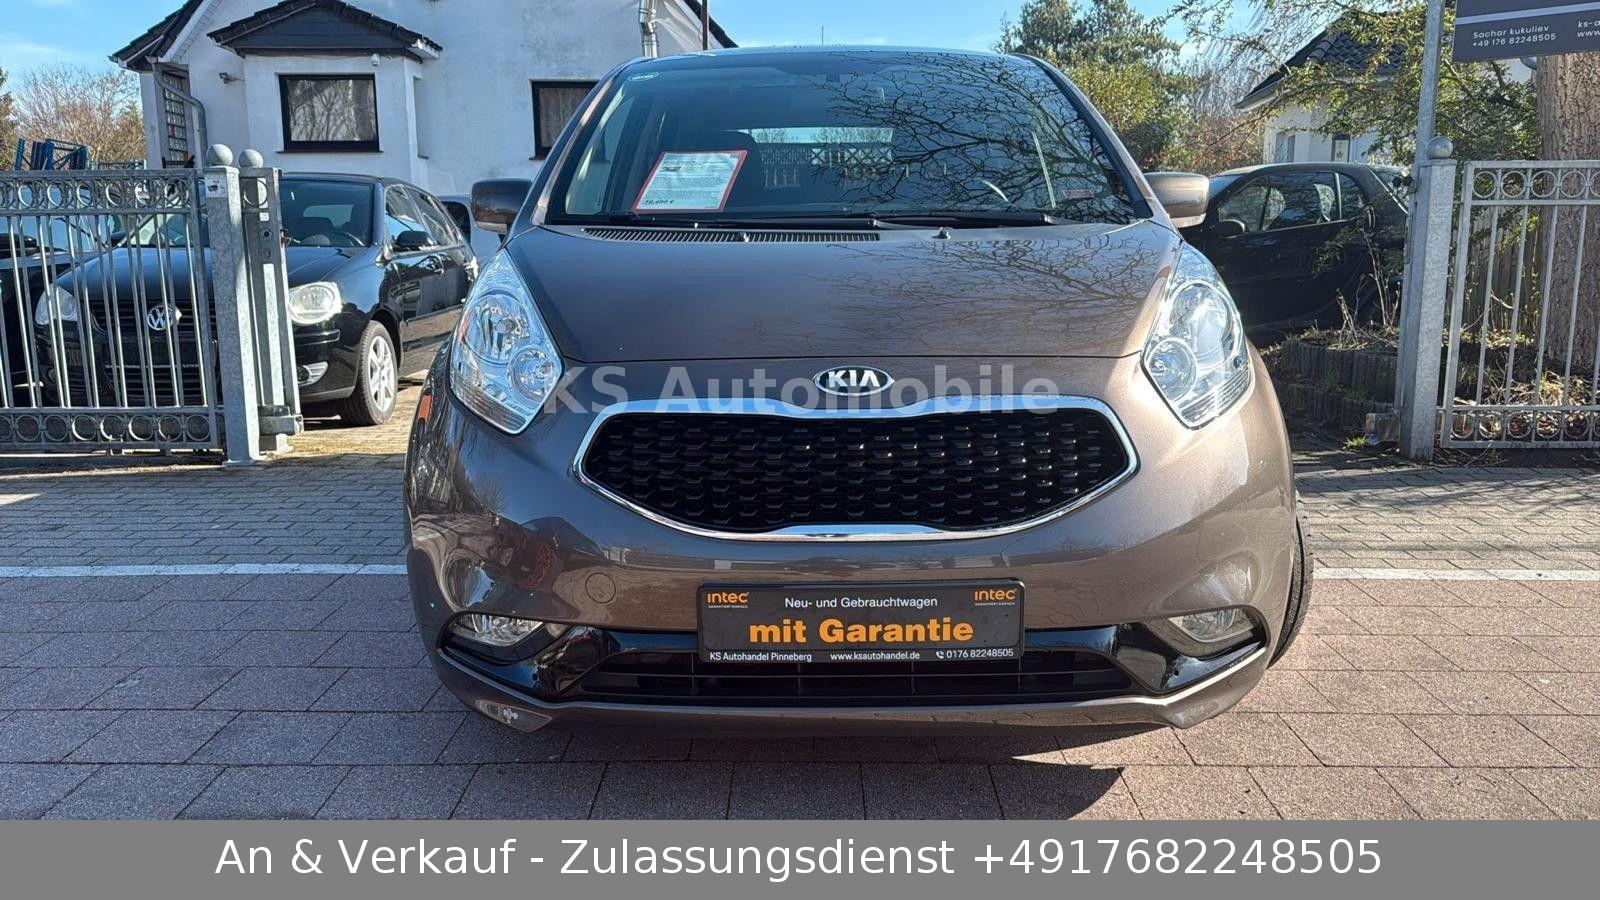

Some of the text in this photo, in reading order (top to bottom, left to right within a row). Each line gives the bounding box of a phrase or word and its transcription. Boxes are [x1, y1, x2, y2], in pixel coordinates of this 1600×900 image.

[1473, 30, 1507, 39] Sachar
[828, 370, 880, 388] KIA
[785, 597, 938, 609] Neu- und Gebrauchtwagen
[750, 616, 974, 643] mit Garantie
[710, 652, 812, 662] KS Autohandel Pinneberg
[830, 651, 920, 661] www.ksautohandel.de
[946, 648, 1014, 659] 0176 82248505
